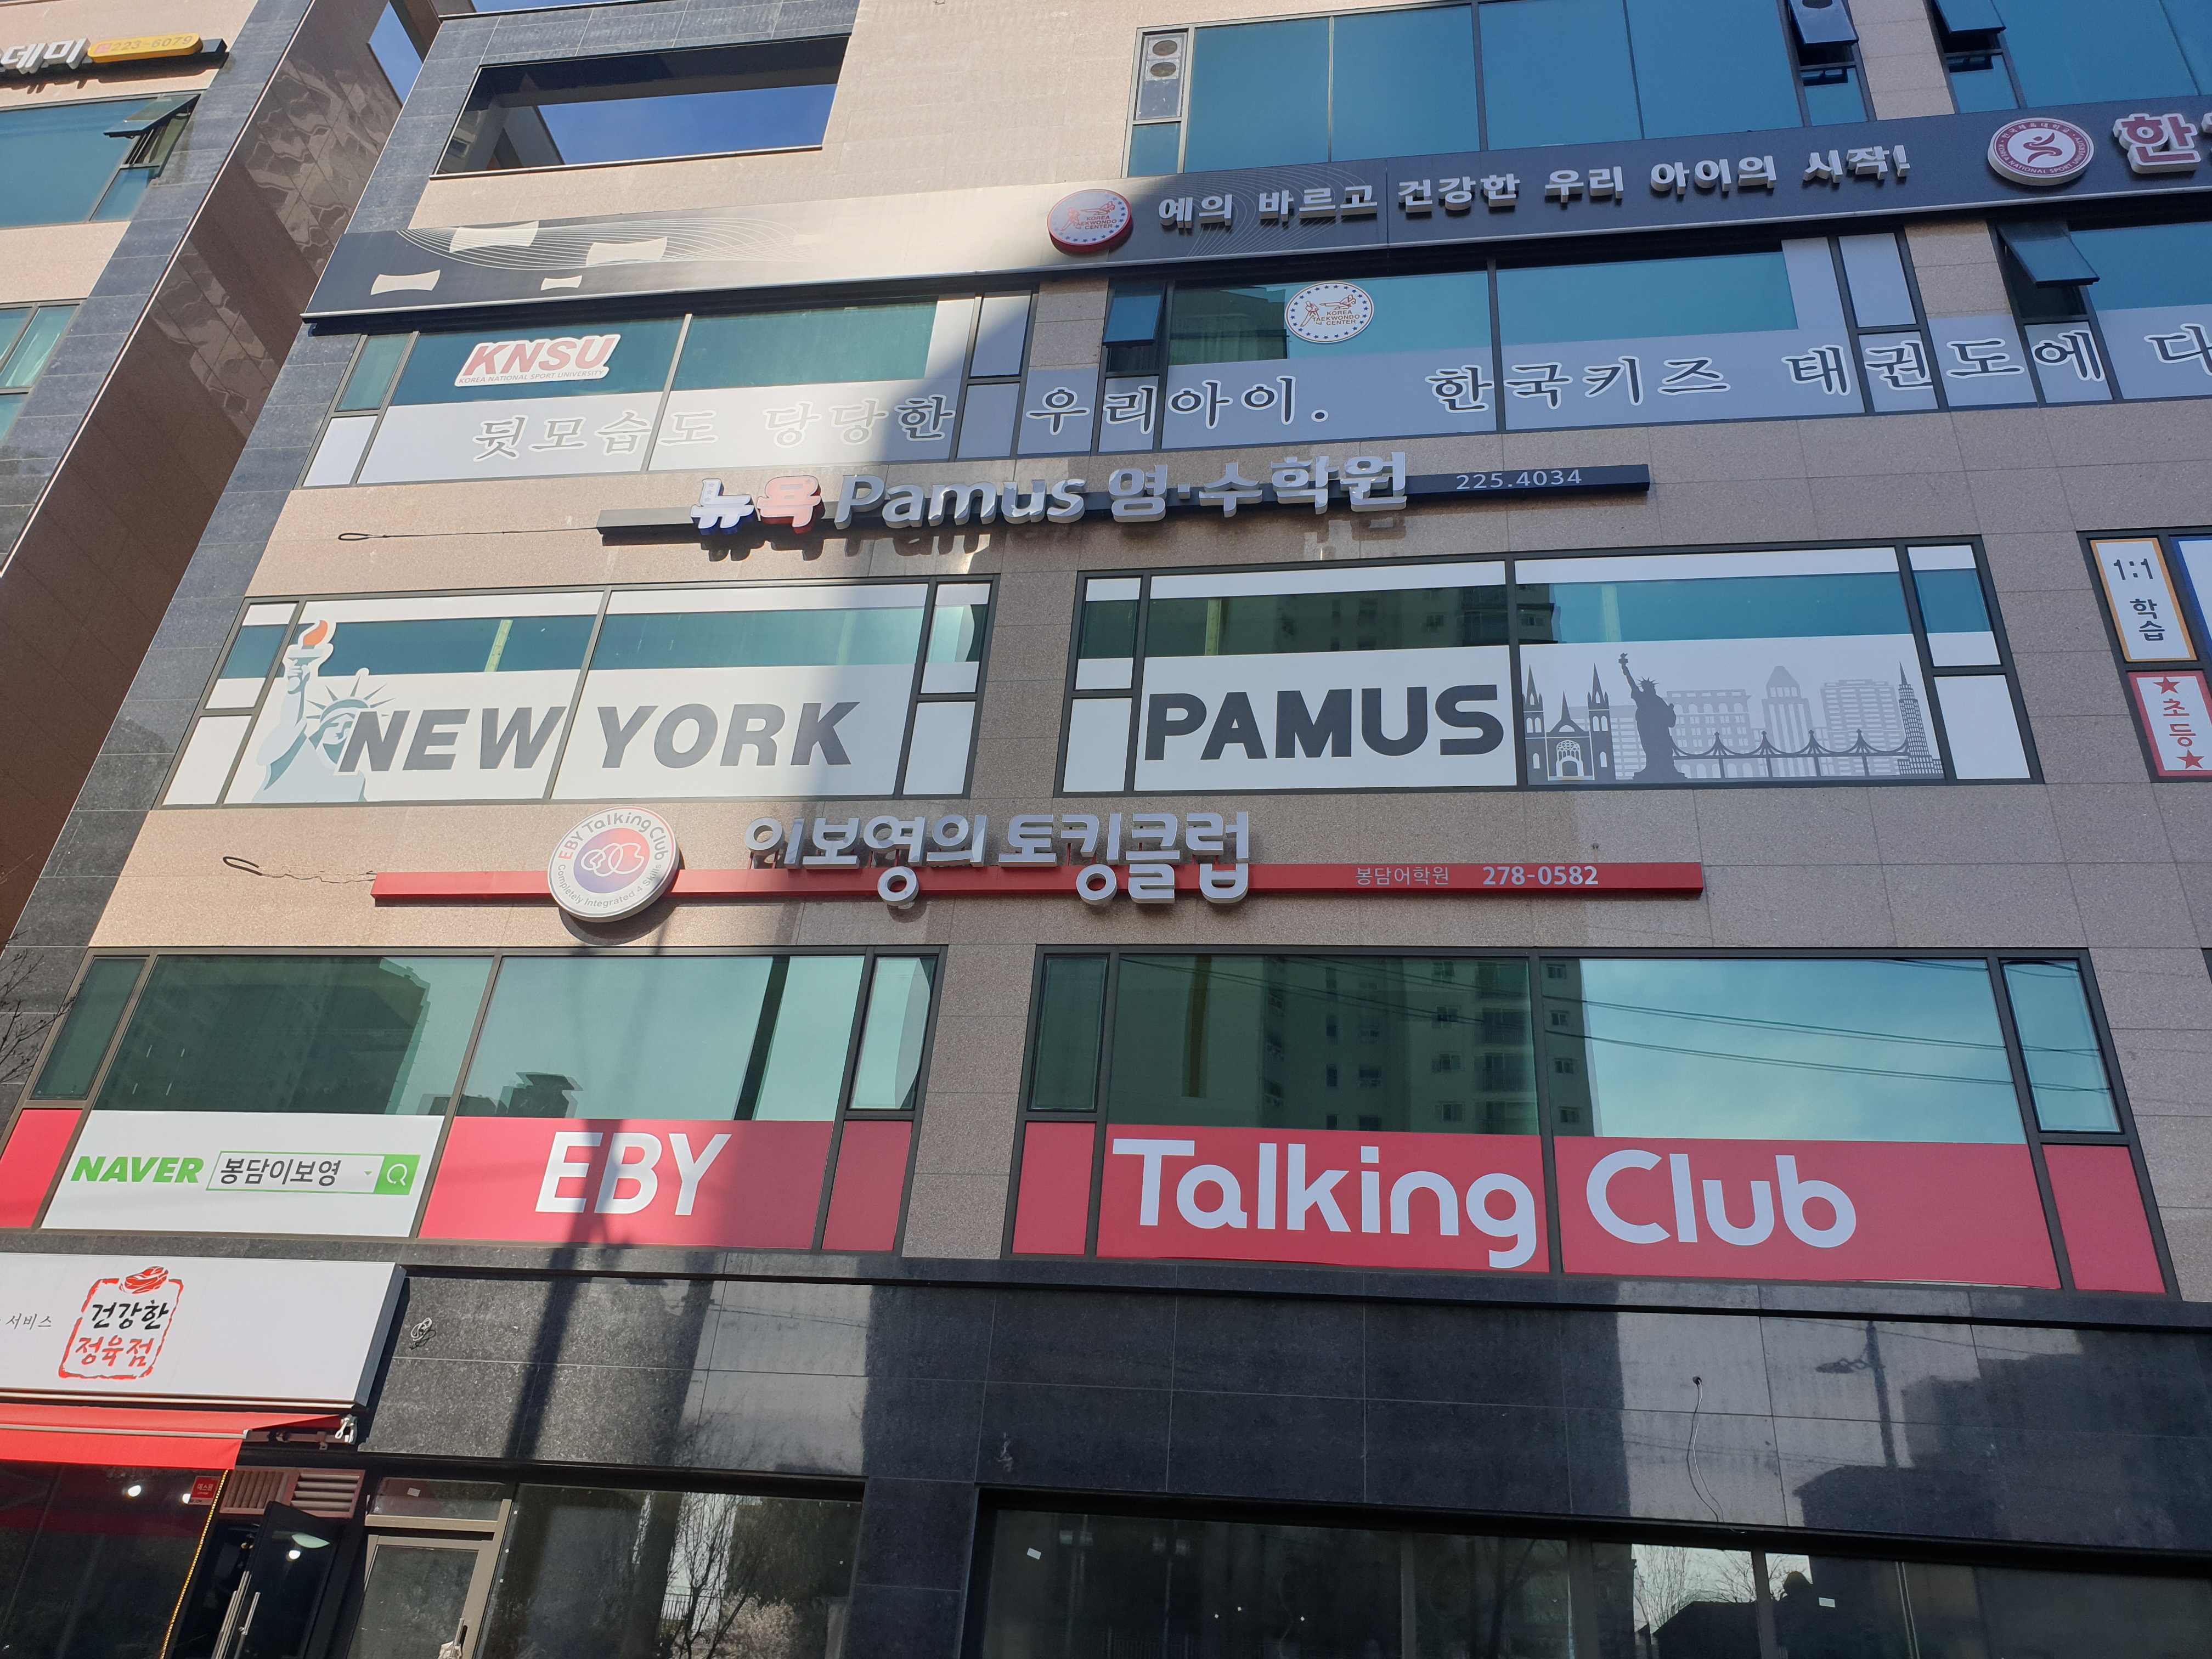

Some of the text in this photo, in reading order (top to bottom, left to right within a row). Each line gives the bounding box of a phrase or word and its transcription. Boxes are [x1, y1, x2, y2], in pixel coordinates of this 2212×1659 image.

[0, 38, 91, 72] 데미
[110, 35, 193, 52] 223-6079
[1997, 143, 2010, 161] KOREA
[2008, 160, 2046, 174] NATIONAL
[2049, 163, 2073, 174] SPORT
[2113, 112, 2212, 174] 한
[1158, 144, 1910, 228] 예의 바르고 건강한 우리 아이의 시작!
[462, 337, 616, 376] KNSU
[487, 374, 528, 382] NATIONAL
[557, 370, 605, 379] UNIVERSITY
[472, 409, 719, 462] 뒷모습도
[763, 394, 956, 448] 당당한
[1425, 356, 1731, 413] 한국키즈
[1781, 329, 2106, 396] 태권도에
[833, 474, 1086, 530] Pamus
[1455, 469, 1582, 490] 225.4034
[2113, 558, 2154, 580] 1:1
[2129, 598, 2165, 641] 학습
[338, 701, 860, 772] NEW YORK
[1143, 684, 1504, 761] PAMUS
[2163, 698, 2196, 747] 초등
[558, 811, 669, 861] EBY Talking Club
[743, 811, 1249, 907] 이보영의 토킹클럽
[1355, 865, 1599, 887] 봉담어학원 278-0582
[557, 864, 584, 904] Completely
[584, 890, 635, 909] Integrated
[642, 864, 662, 888] Skills
[70, 1156, 342, 1187] NAVER 봉담이보영
[535, 1131, 732, 1216] EBY
[1112, 1138, 1858, 1269] Talking Club
[5, 1313, 52, 1330] 서비스
[92, 1299, 170, 1330] 건강한
[75, 1335, 155, 1368] 정육점
